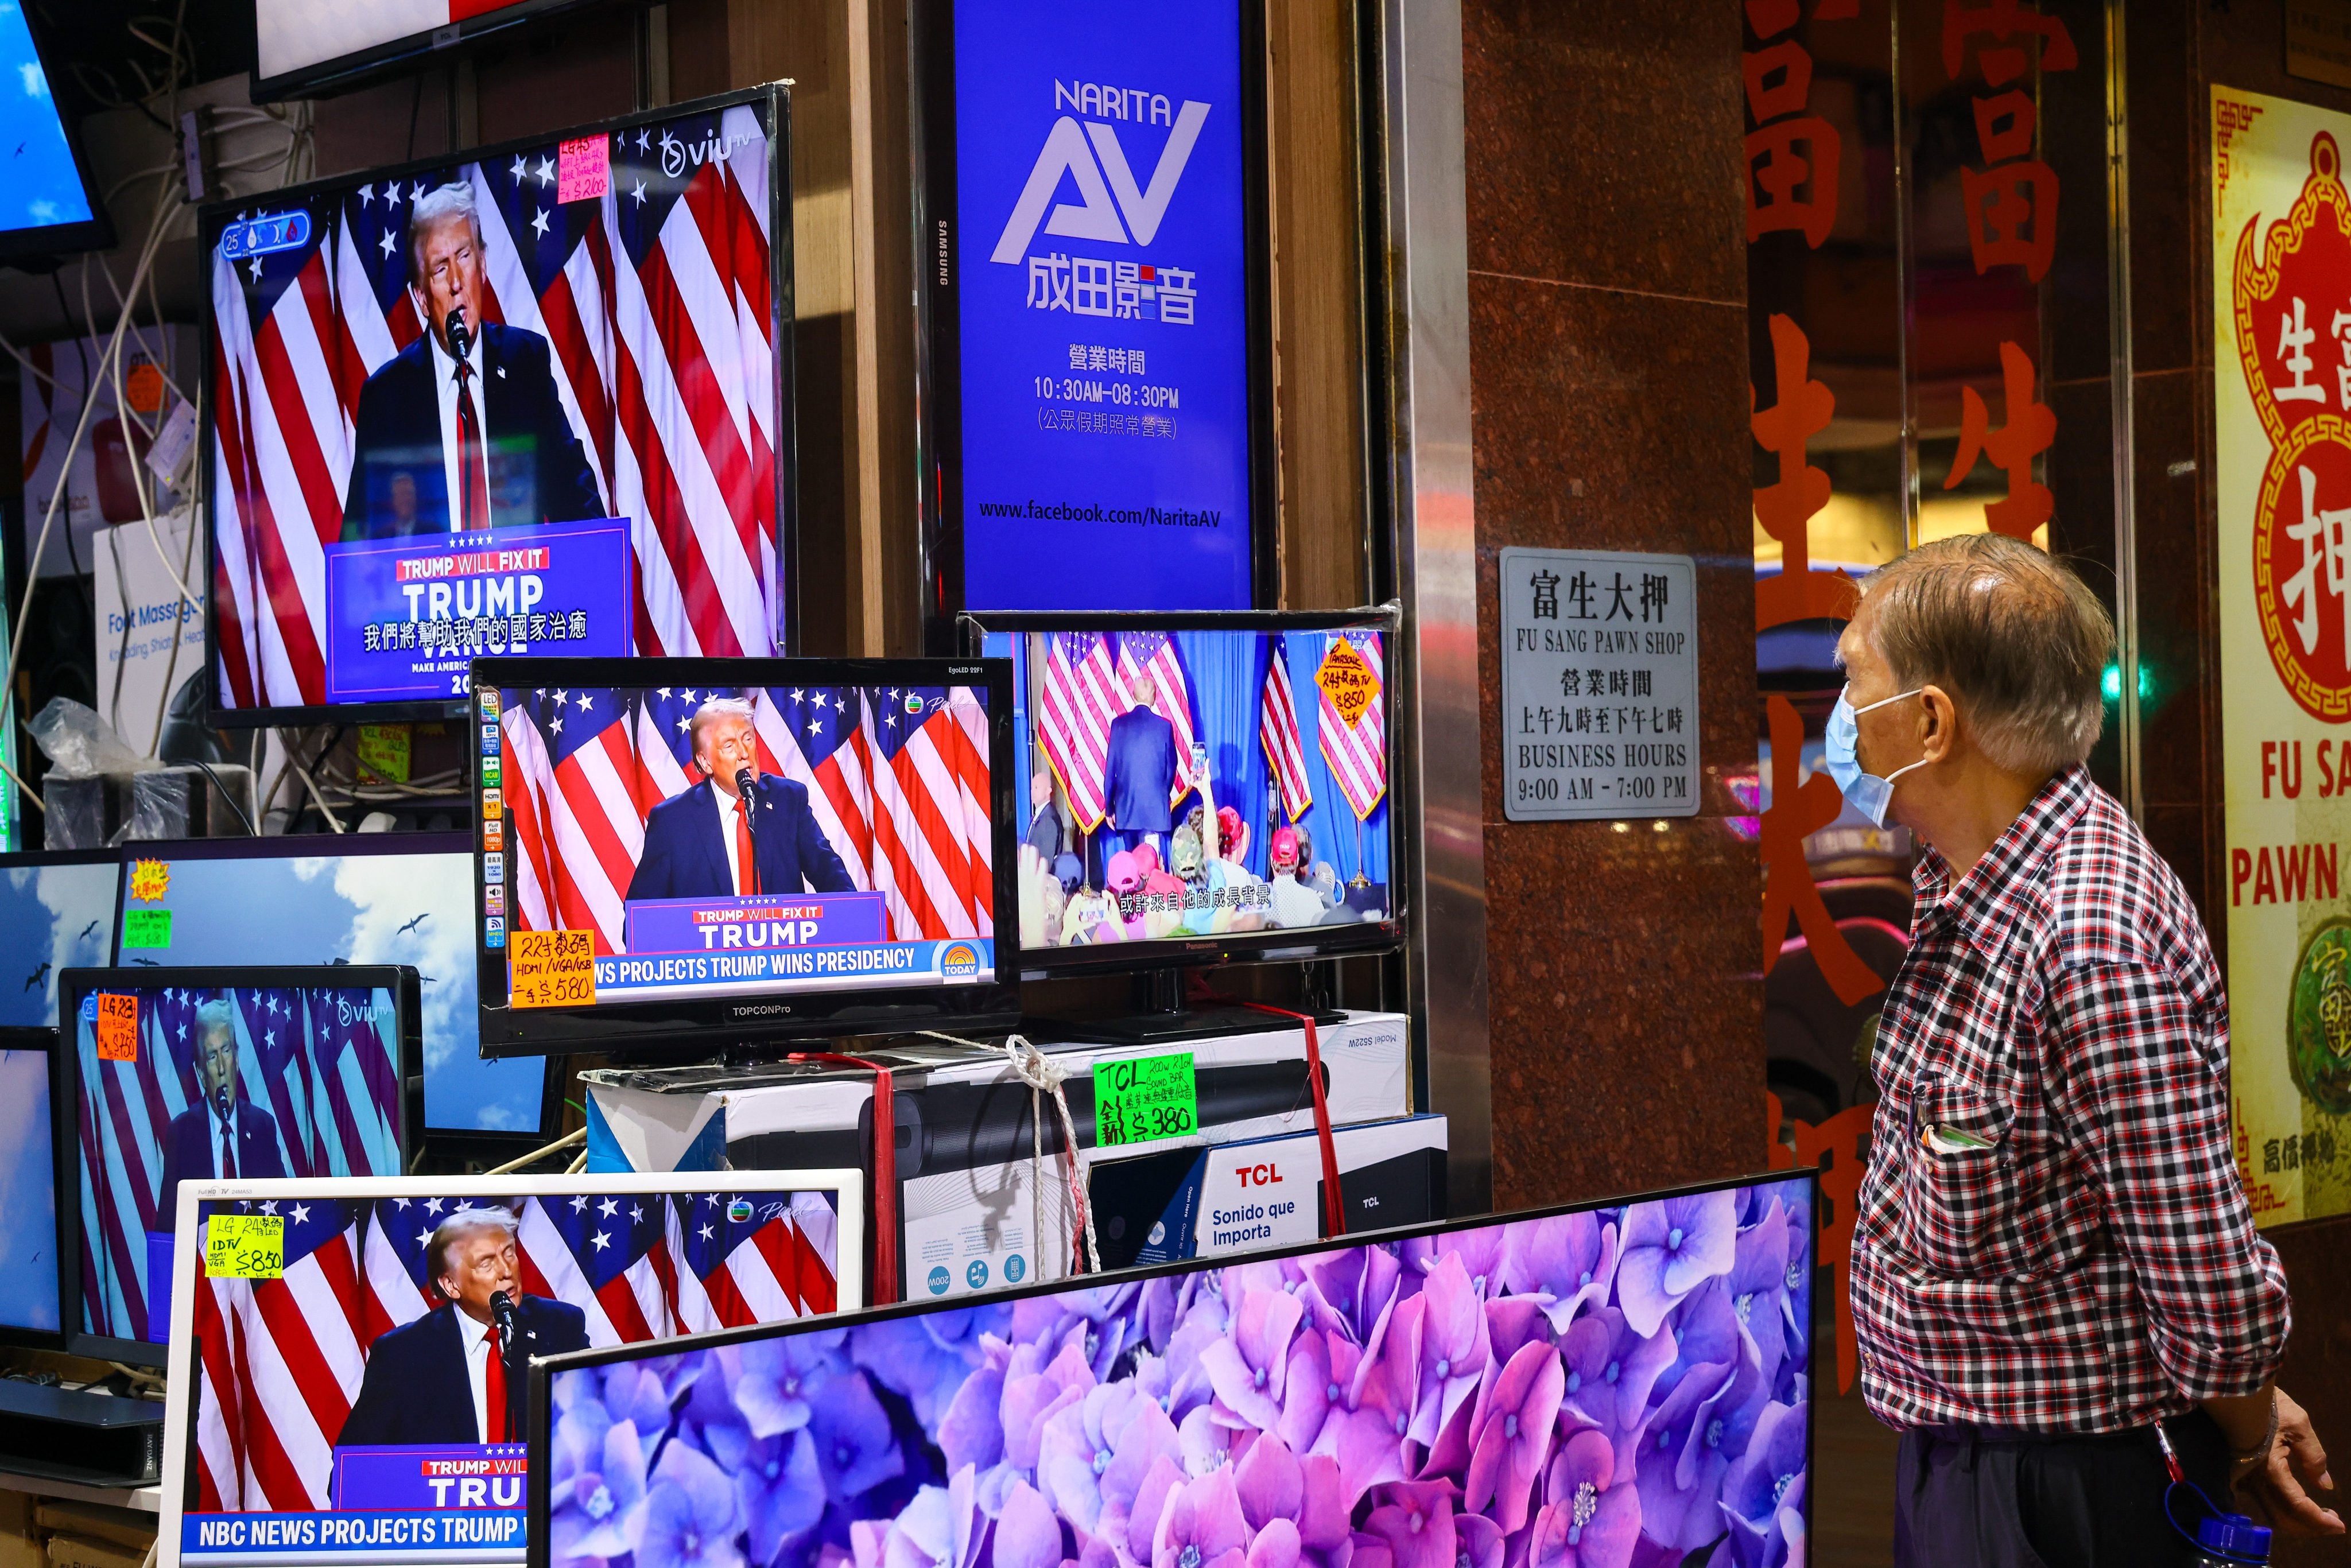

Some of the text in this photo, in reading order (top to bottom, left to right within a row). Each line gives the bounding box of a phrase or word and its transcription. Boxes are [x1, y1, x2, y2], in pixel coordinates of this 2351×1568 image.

[1054, 77, 1171, 127] NARITA
[990, 100, 1212, 266] AV
[938, 220, 948, 286] SAMSUNG
[1069, 343, 1146, 376] 營業時間
[1034, 376, 1179, 409] 10:30AM-08:30PM
[1037, 406, 1177, 440] (公眾假期照常營業)
[979, 499, 1221, 528] www.facebook.com/NaritaAV
[403, 549, 543, 579] TRUMP WILL FIX IT
[402, 574, 544, 623] TRUMP
[1530, 569, 1668, 623] 富生大押
[108, 608, 136, 634] Fot
[364, 610, 587, 653] 我們將幫助我們的國家治癒
[1516, 628, 1685, 655] FU SANG PAWN SHOP
[412, 661, 470, 673] MAKE AMERIC
[1561, 668, 1652, 697] 營業時間
[484, 693, 498, 704] LED
[1519, 706, 1682, 734] 上午九時至下午七時
[1519, 744, 1686, 769] BUSINESS HOURS
[2261, 739, 2301, 800] FU
[1519, 778, 1558, 801] 9:00
[1567, 778, 1593, 800] AM
[1617, 777, 1655, 799] 7:00
[1663, 776, 1687, 798] PM
[486, 836, 501, 844] 1080p
[2232, 844, 2337, 907] PAWN
[1120, 884, 1270, 914] 或許來自他的成長背景
[699, 906, 817, 922] TRUMP WILL FIX IT
[699, 921, 818, 949] TRUMP
[620, 958, 707, 982] PROJECTS
[711, 955, 766, 977] TRUMP
[771, 952, 813, 974] WINS
[817, 948, 914, 972] PRESIDENCY
[945, 965, 976, 975] TODAY
[85, 1003, 93, 1015] 25
[102, 997, 116, 1016] LG
[733, 1005, 791, 1016] TOPCONPro
[1348, 1034, 1396, 1048] Model S522W
[1100, 1061, 1146, 1091] TCL
[1132, 1106, 1191, 1143] $380
[1236, 1163, 1283, 1187] TCL
[1212, 1200, 1295, 1226] Sonido que
[1363, 1197, 1379, 1208] TCL
[216, 1217, 235, 1235] LG
[1213, 1225, 1271, 1247] Importa
[928, 1275, 949, 1287] 200W
[429, 1461, 490, 1475] TRUMP
[429, 1477, 521, 1507] TRU
[199, 1517, 518, 1546] NBC NEWS PROJECTS TRUMP
